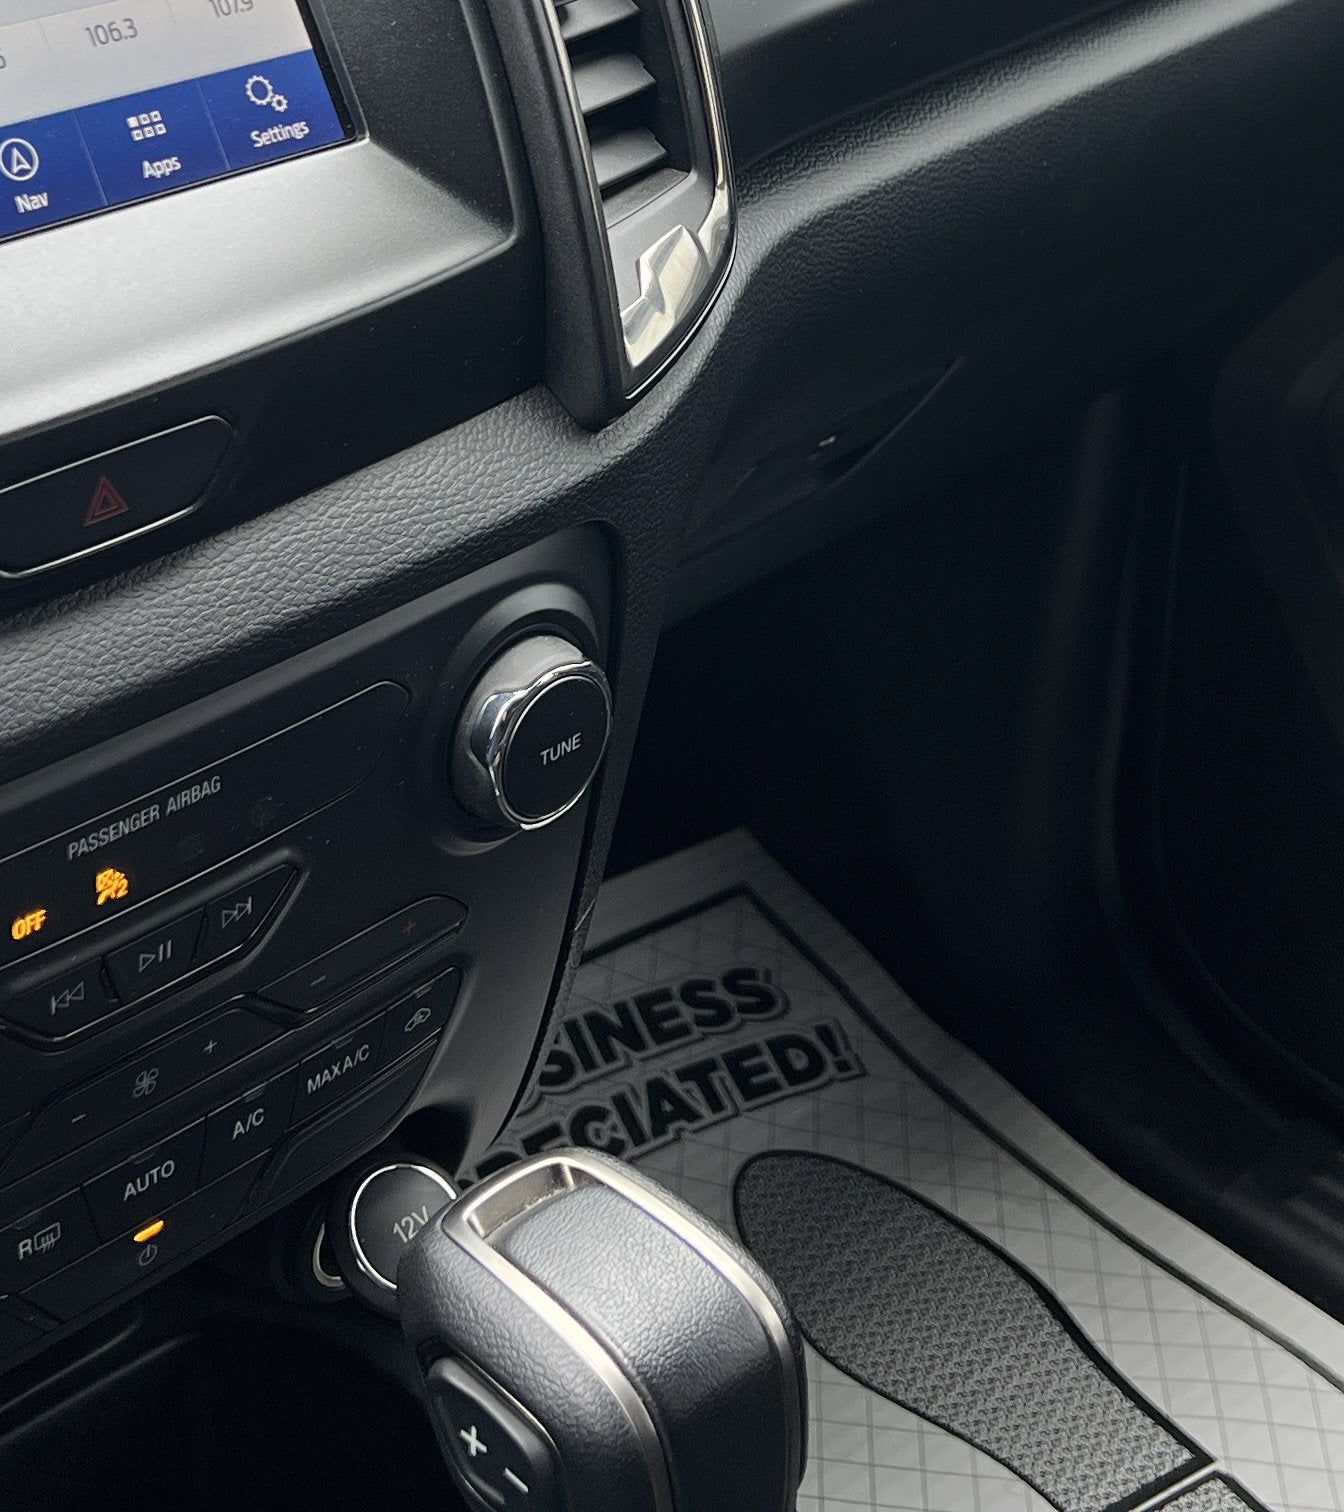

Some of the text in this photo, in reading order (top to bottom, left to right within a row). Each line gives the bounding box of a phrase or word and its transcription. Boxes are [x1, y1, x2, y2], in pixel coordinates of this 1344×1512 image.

[84, 17, 139, 48] 106.3
[249, 118, 311, 149] Settings
[141, 154, 182, 180] Apps
[14, 190, 49, 214] Nav
[540, 732, 582, 766] TUNE
[67, 775, 221, 862] PASSENGER AIRBAG
[11, 907, 48, 940] OFF
[538, 966, 781, 1088] SINESS
[307, 1044, 371, 1095] MAX A/C
[232, 1107, 265, 1141] A/C
[123, 1159, 176, 1202] AUTO
[392, 1205, 429, 1243] 12V
[17, 1240, 34, 1260] R
